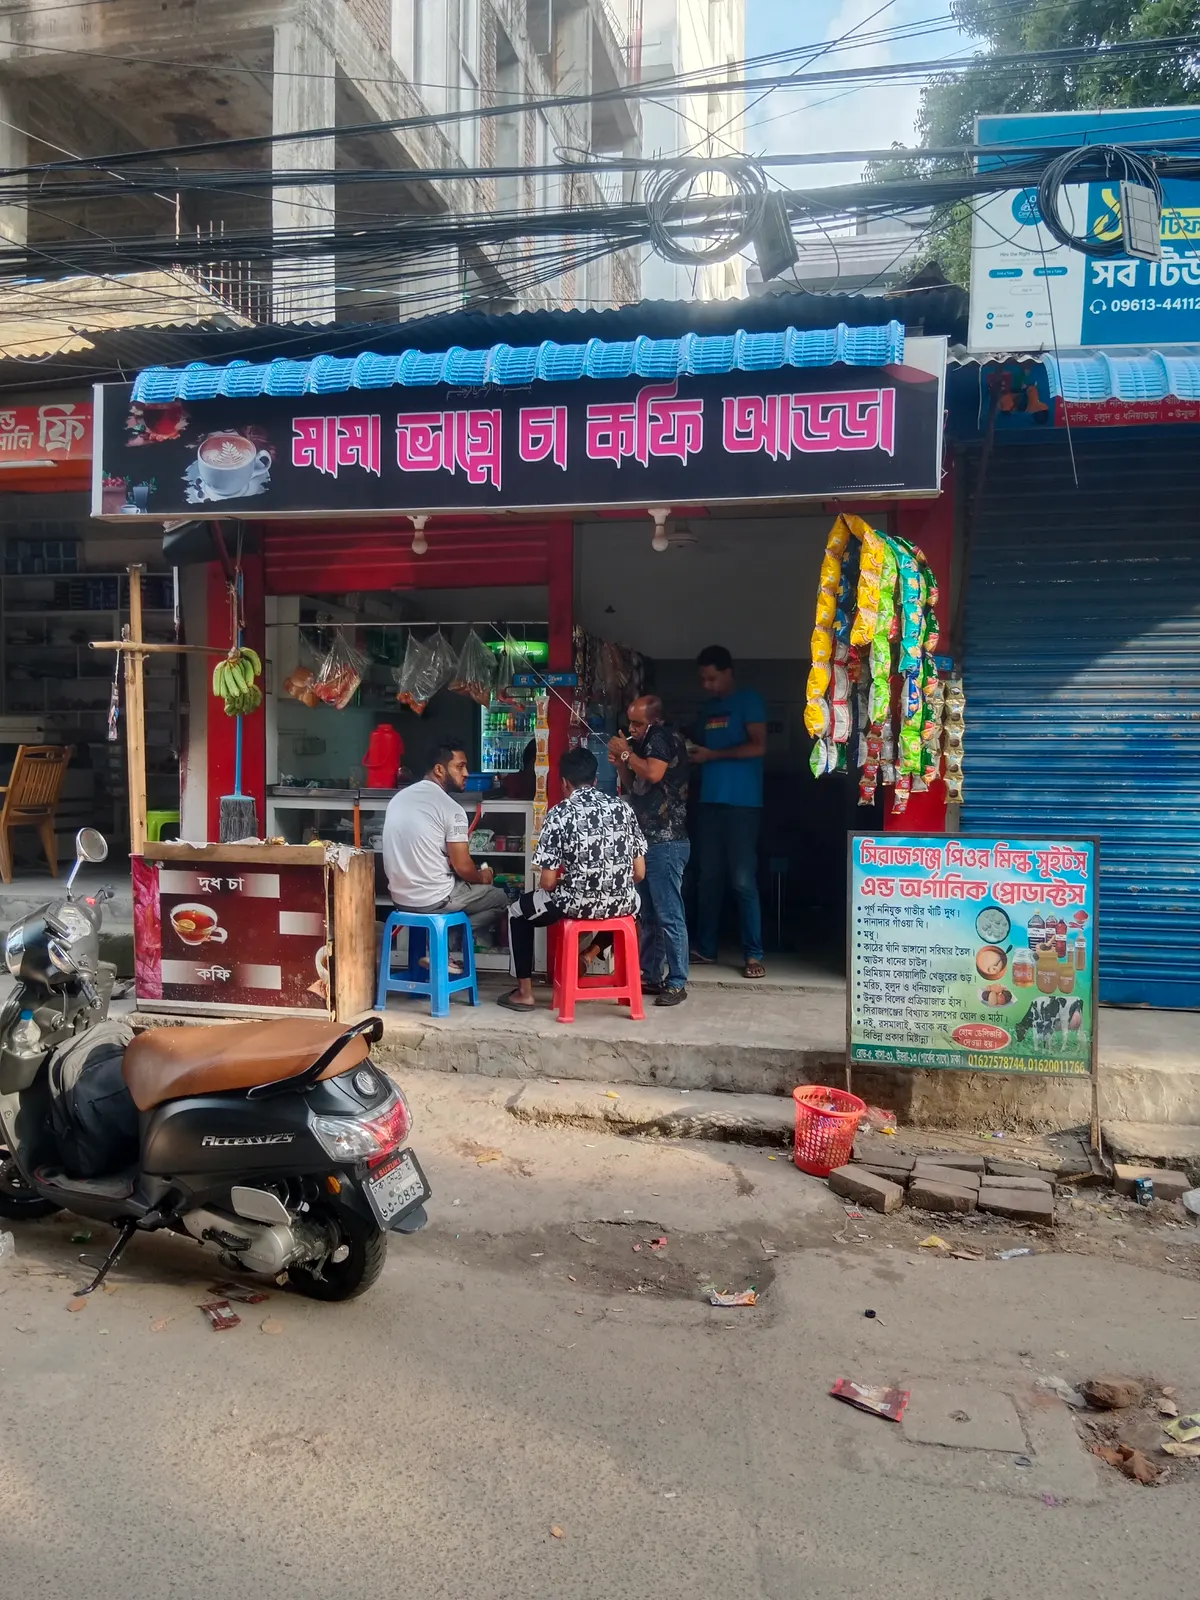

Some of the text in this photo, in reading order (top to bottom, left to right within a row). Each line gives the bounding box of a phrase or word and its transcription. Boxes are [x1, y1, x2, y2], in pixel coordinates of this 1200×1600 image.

[1091, 260, 1140, 288] সব
[292, 374, 896, 491] মামা ভাগ্নে চা কফি আড্ডা
[859, 840, 942, 871] সিরাজগঞ্জ
[945, 842, 990, 869] পিওর
[994, 842, 1032, 873] মিল্ক
[197, 876, 246, 893] দুধ চা
[860, 872, 1086, 906] এন্ড অর্গানিক প্রোডাক্টস
[864, 903, 876, 916] পূর্ণ
[877, 904, 902, 918] ননিযুক্ত
[904, 904, 924, 916] গাভীর
[864, 918, 890, 927] দানাদার
[864, 941, 883, 952] কাঠের
[902, 944, 926, 954] ভাঙ্গানো
[929, 944, 953, 956] সরিষার
[864, 954, 884, 966] আউস
[886, 956, 906, 966] ধানের
[196, 964, 232, 982] কফি
[864, 968, 890, 978] প্রিমিয়াম
[893, 968, 926, 980] কোয়ালিটি
[929, 973, 958, 984] খেজুরের
[863, 980, 882, 992] মরিচ,
[884, 982, 900, 994] হলুদ
[884, 993, 906, 1004] বিলের
[905, 1006, 929, 1018] বিখ্যাত
[960, 1012, 977, 1021] ঘোল
[863, 1029, 882, 1042] বিভিন্ন
[884, 1032, 904, 1042] প্রকার
[378, 1158, 401, 1177] SUZUKI
